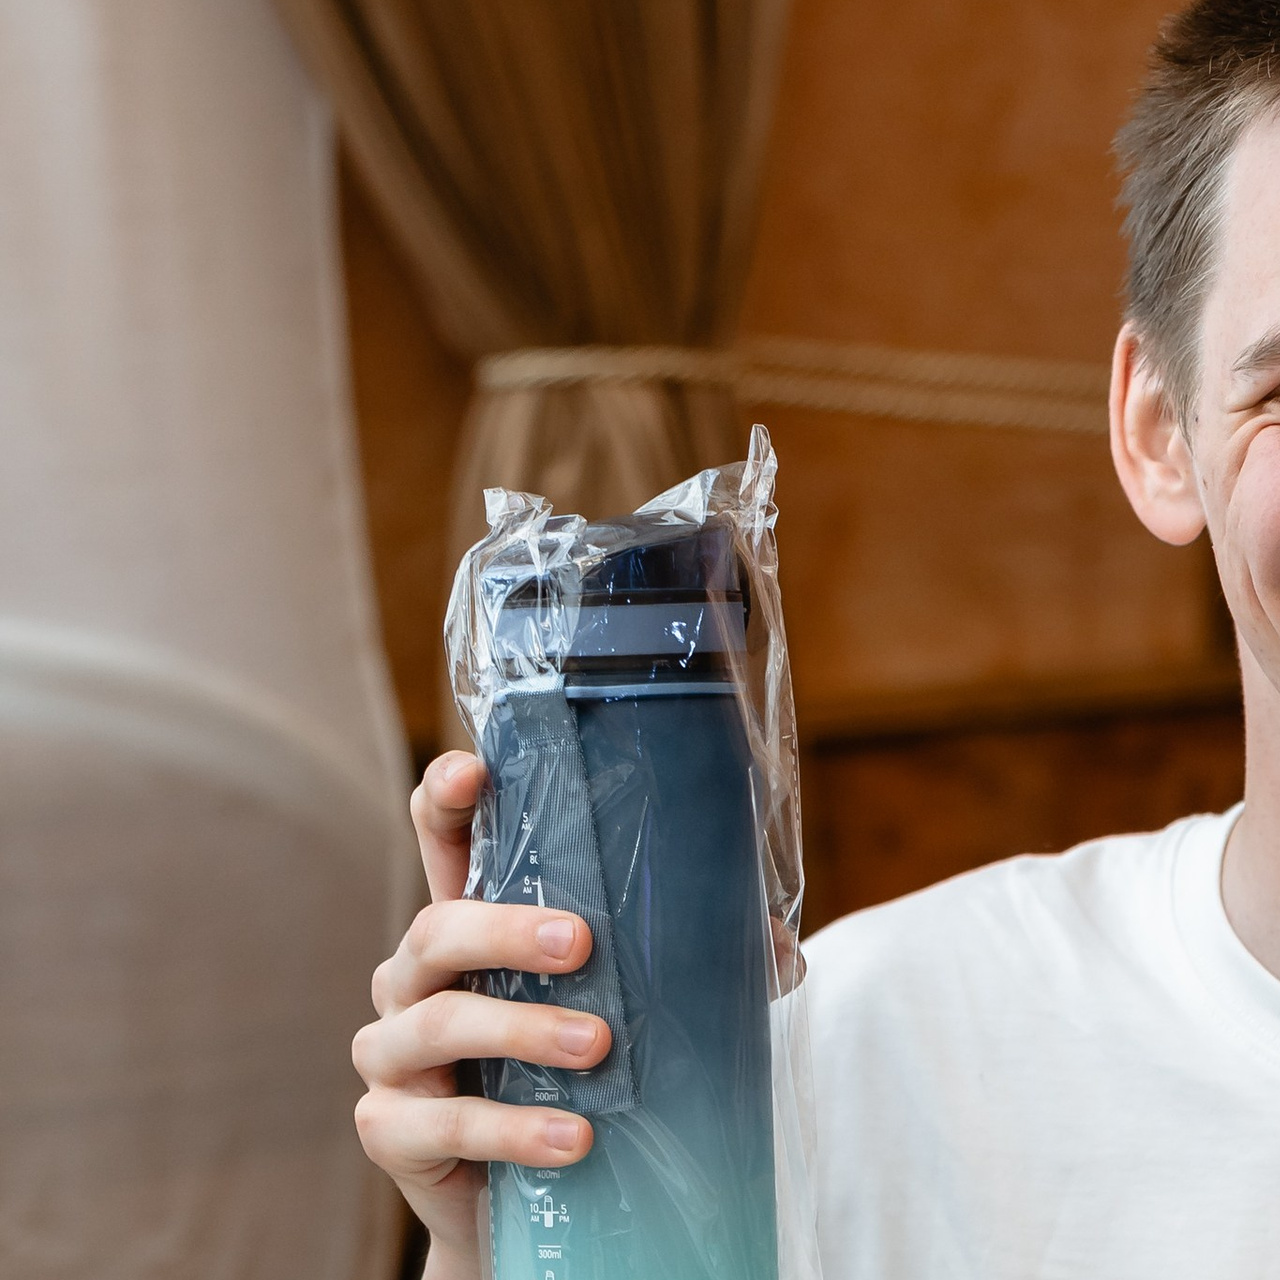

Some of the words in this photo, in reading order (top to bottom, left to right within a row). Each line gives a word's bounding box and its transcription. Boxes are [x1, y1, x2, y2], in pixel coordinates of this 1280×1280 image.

[522, 812, 529, 823] 5
[524, 875, 530, 886] 6
[523, 886, 533, 894] AM
[534, 1092, 559, 1101] 500ml
[536, 1170, 561, 1179] 400ml
[529, 1203, 539, 1213] 10
[560, 1204, 567, 1215] 5
[559, 1215, 570, 1223] PM
[538, 1249, 562, 1259] 300ml
